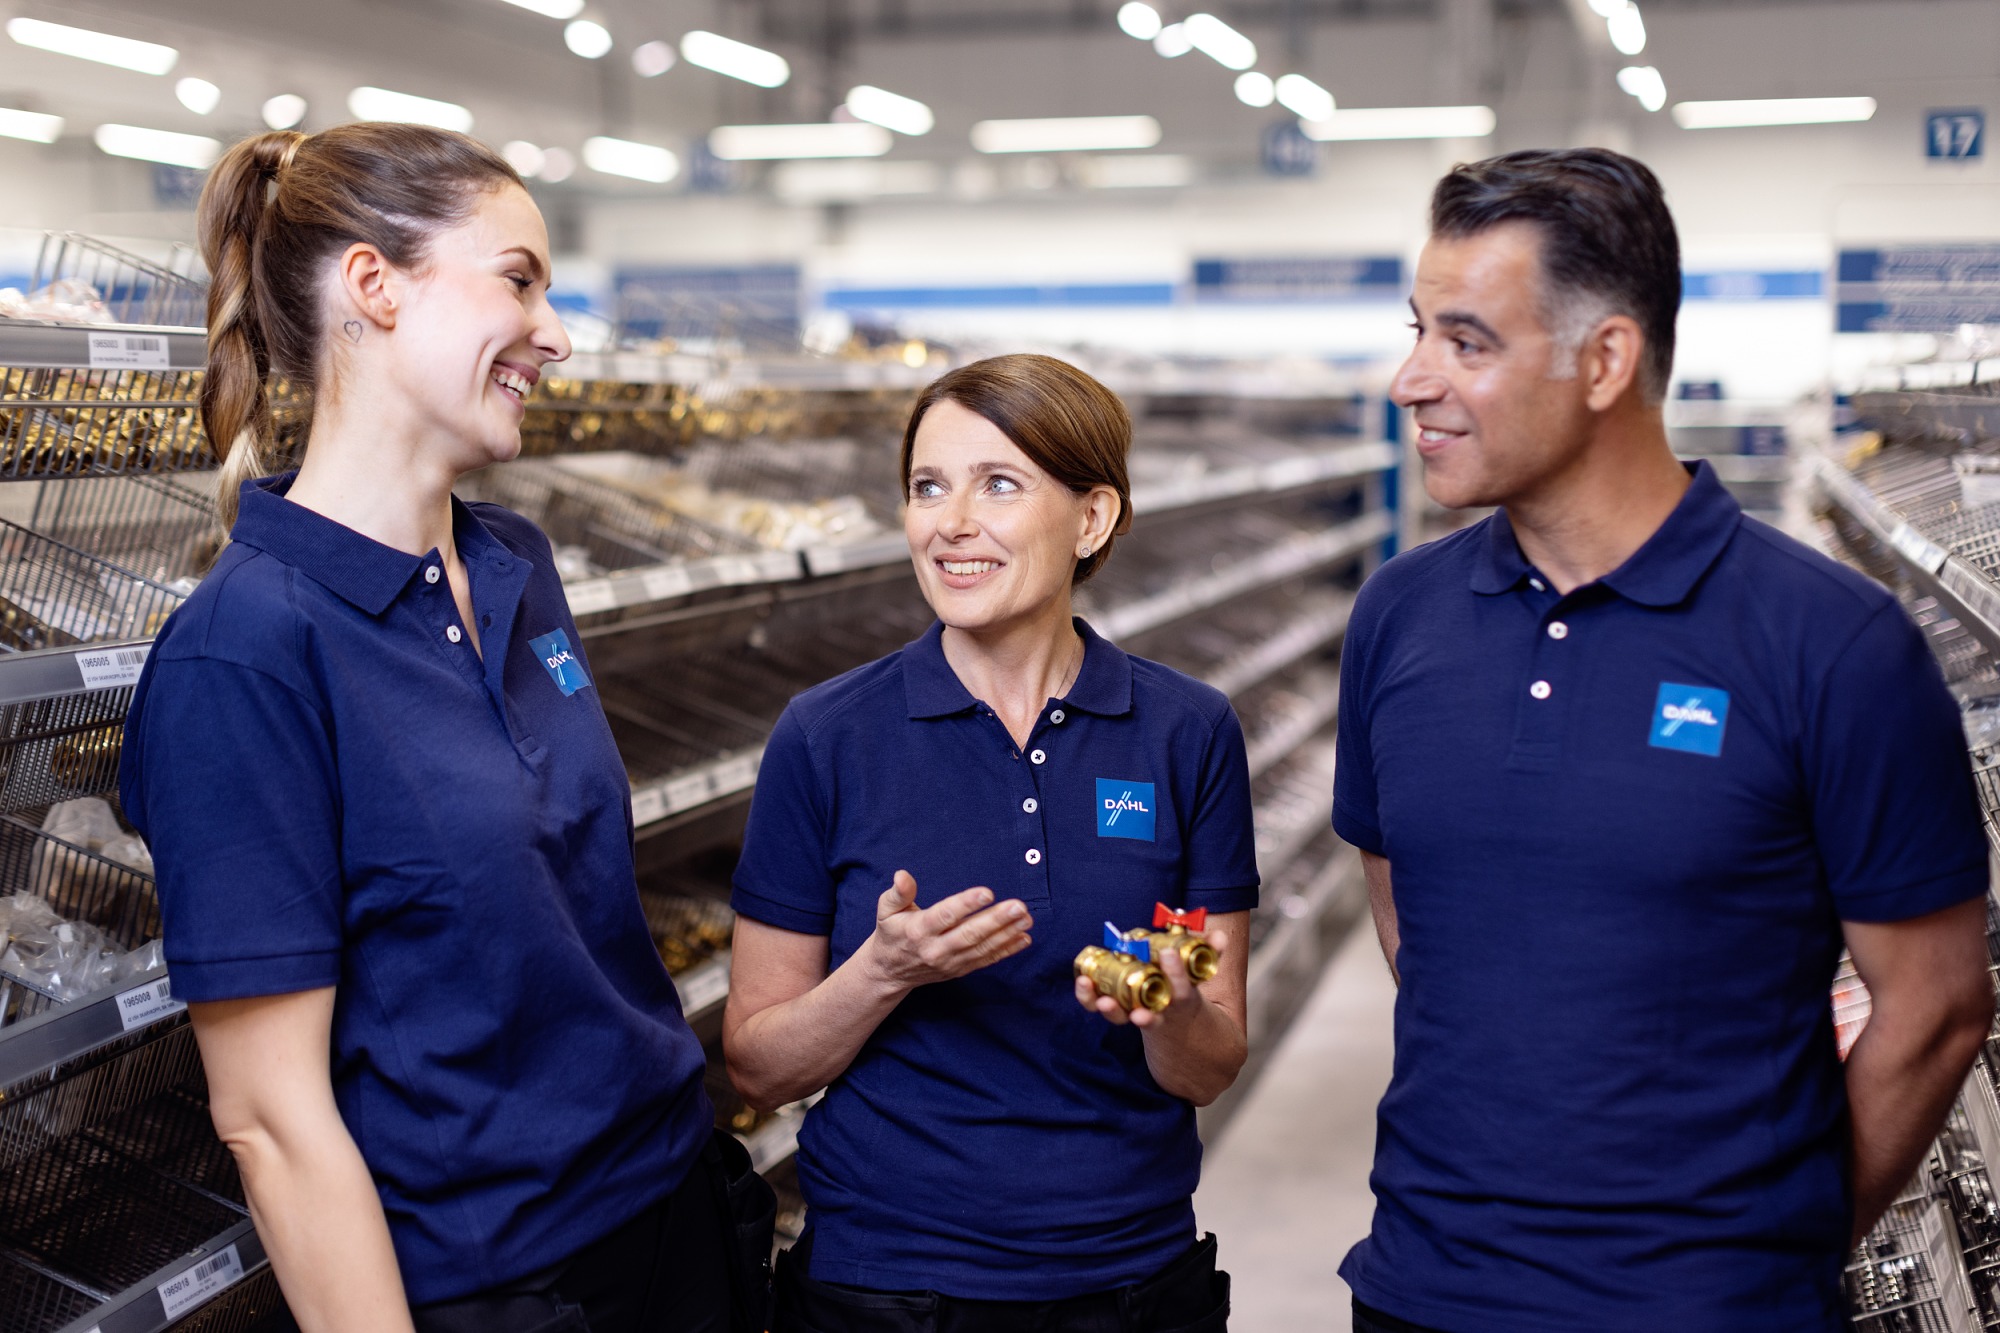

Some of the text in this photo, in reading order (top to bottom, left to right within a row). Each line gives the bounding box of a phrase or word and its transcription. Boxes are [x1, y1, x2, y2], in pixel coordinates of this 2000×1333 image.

[81, 656, 110, 668] 1965005
[1662, 703, 1718, 726] DAHL
[1104, 798, 1149, 812] DAHL
